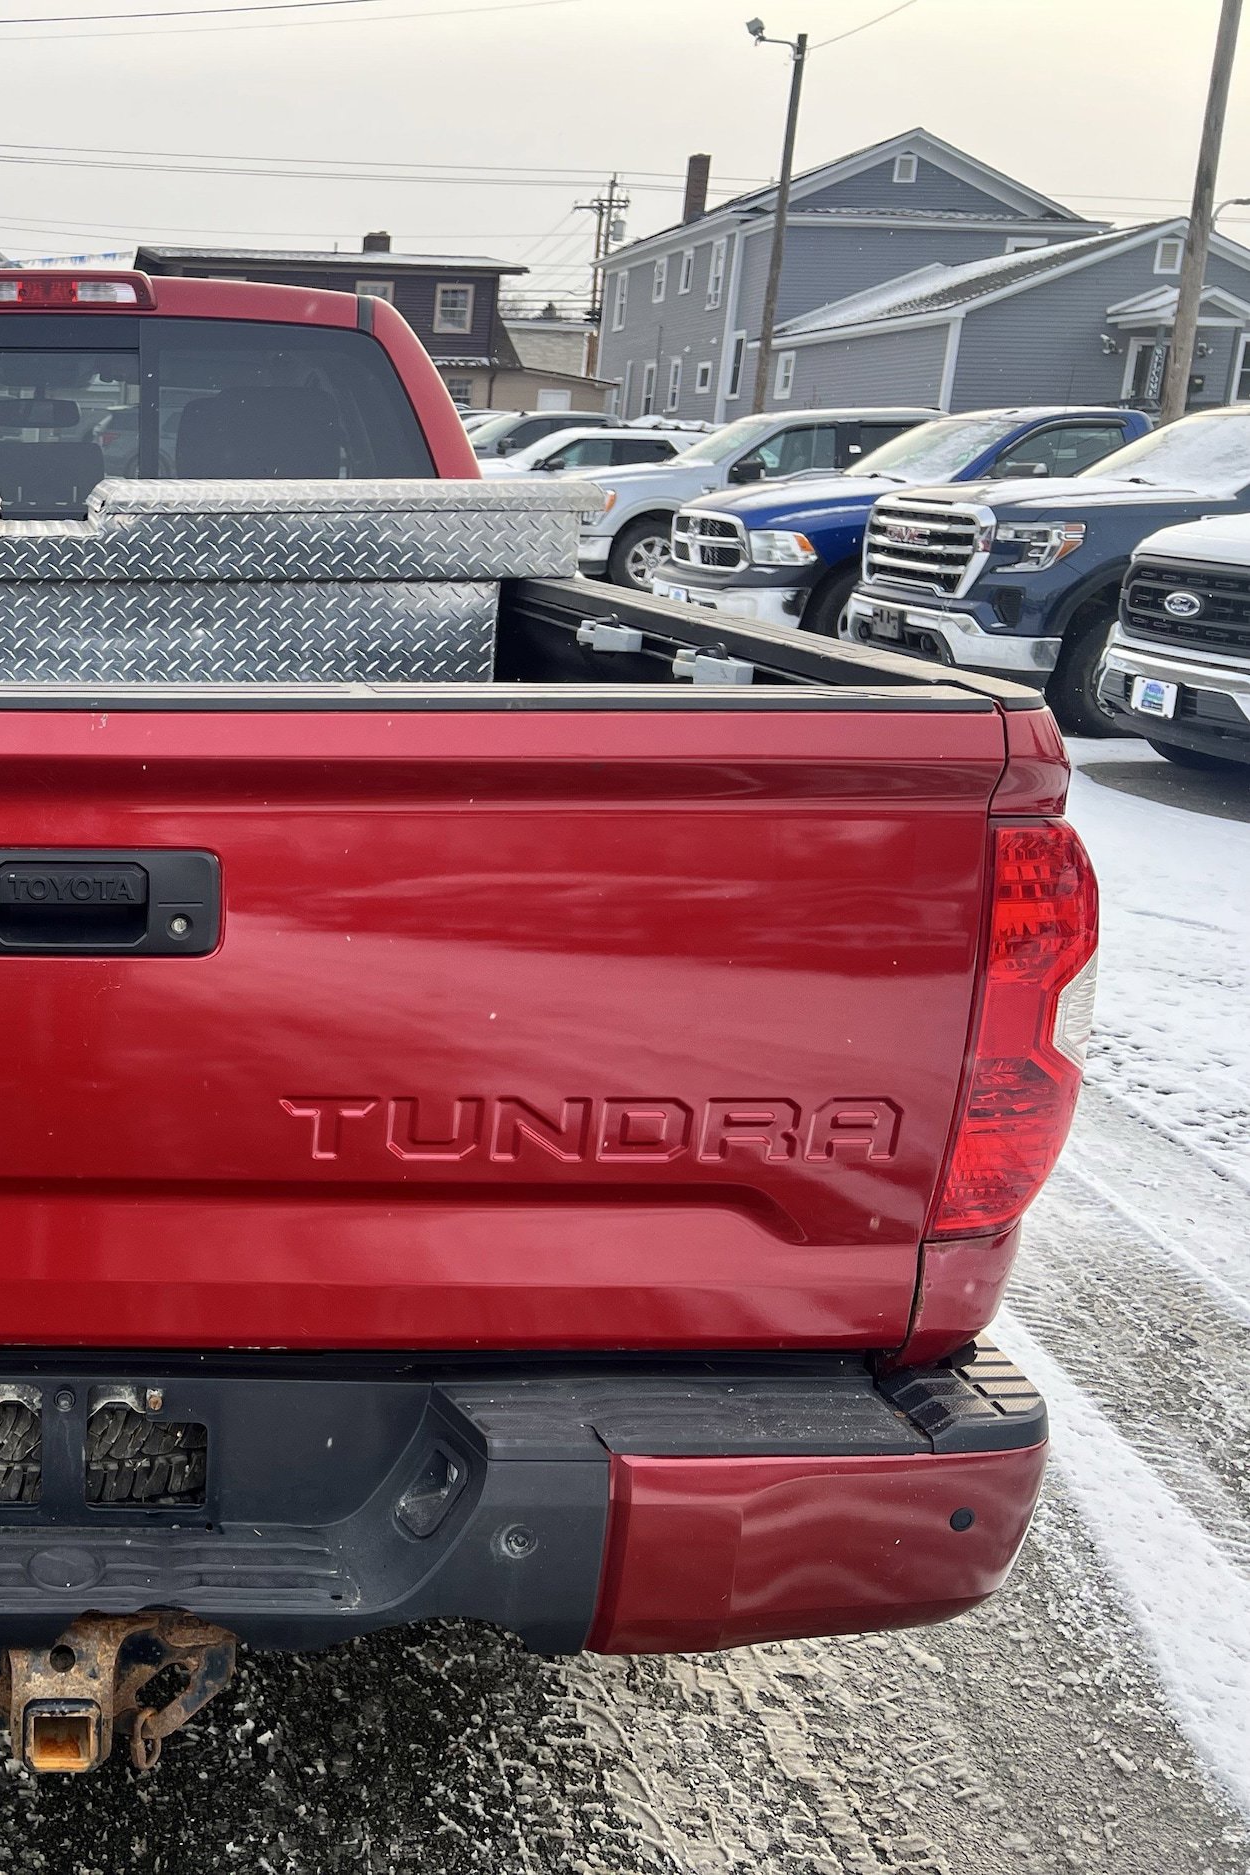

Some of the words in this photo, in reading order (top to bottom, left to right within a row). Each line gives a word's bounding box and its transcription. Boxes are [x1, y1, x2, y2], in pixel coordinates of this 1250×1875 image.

[885, 524, 931, 546] GMC
[7, 874, 136, 902] TOYOTA
[278, 1095, 905, 1163] TUNDRA
